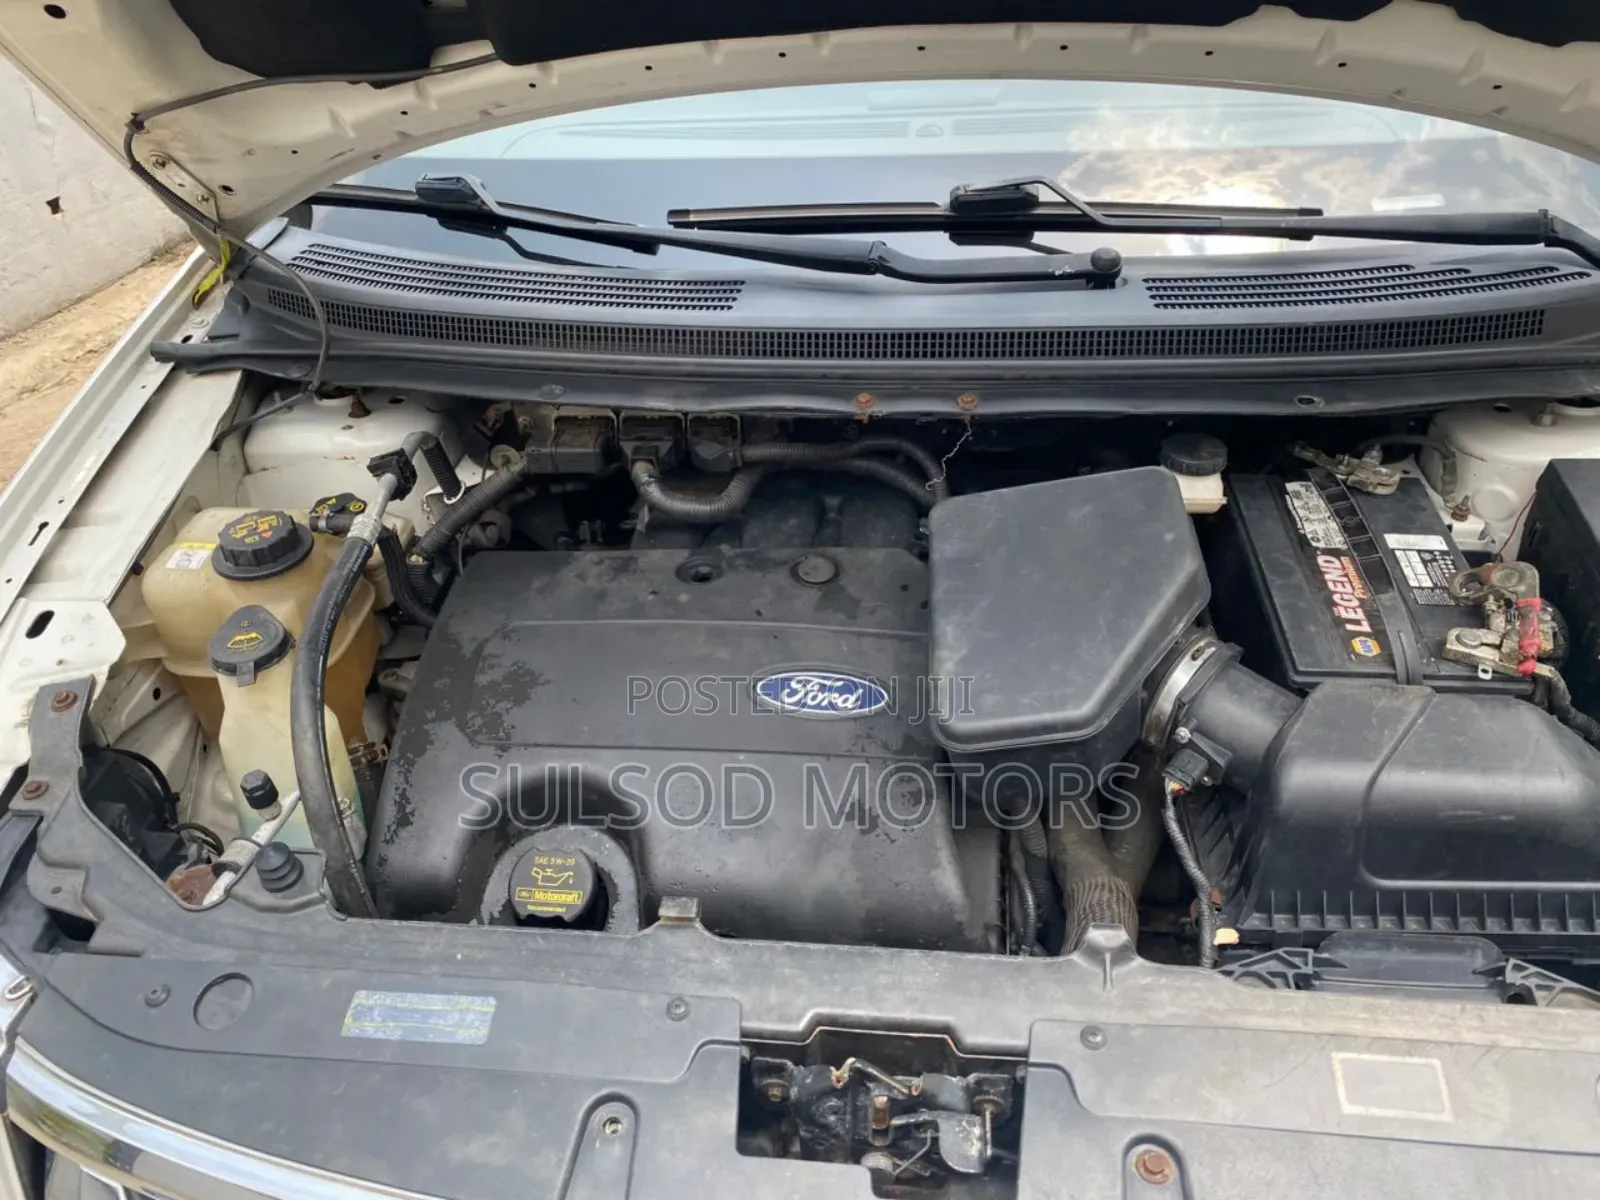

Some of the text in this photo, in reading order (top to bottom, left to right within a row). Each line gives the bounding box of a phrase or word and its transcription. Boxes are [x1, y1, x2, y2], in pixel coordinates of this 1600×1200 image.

[1316, 554, 1373, 633] LEGEND
[780, 675, 864, 708] Ford
[534, 855, 576, 866] SAE 5W-20
[534, 889, 580, 902] Motorcraft
